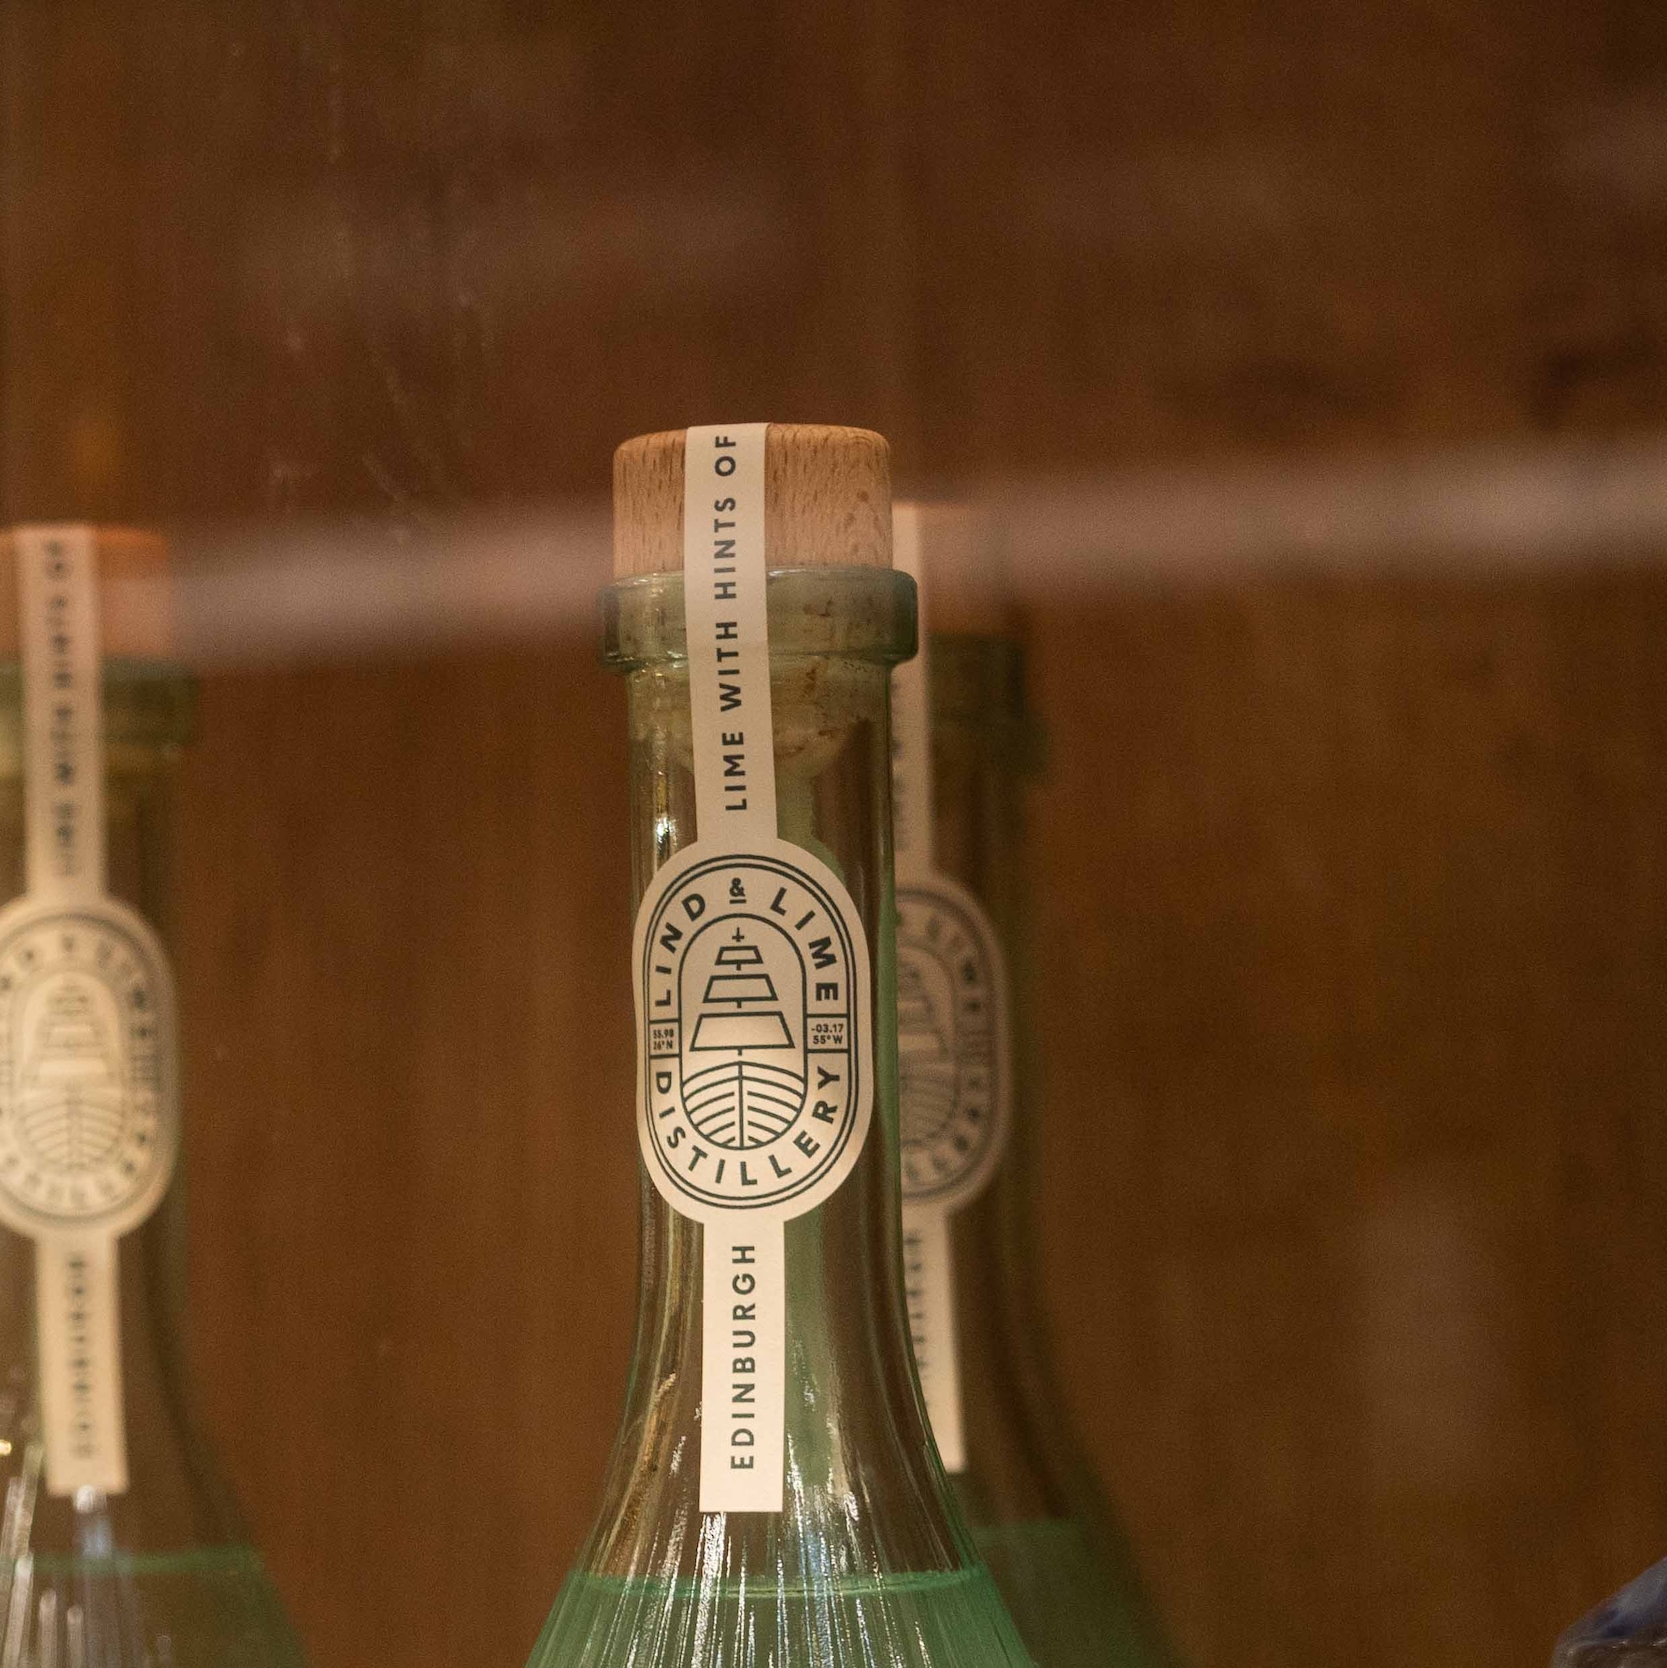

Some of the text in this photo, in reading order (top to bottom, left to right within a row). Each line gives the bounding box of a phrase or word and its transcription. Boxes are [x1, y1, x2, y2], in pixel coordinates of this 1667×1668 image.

[713, 435, 748, 812] LIME WITH HINTS OF
[654, 877, 839, 1008] LIND & LIME
[655, 1066, 841, 1186] DISTILLERY
[730, 1245, 756, 1470] EDINBURGH
